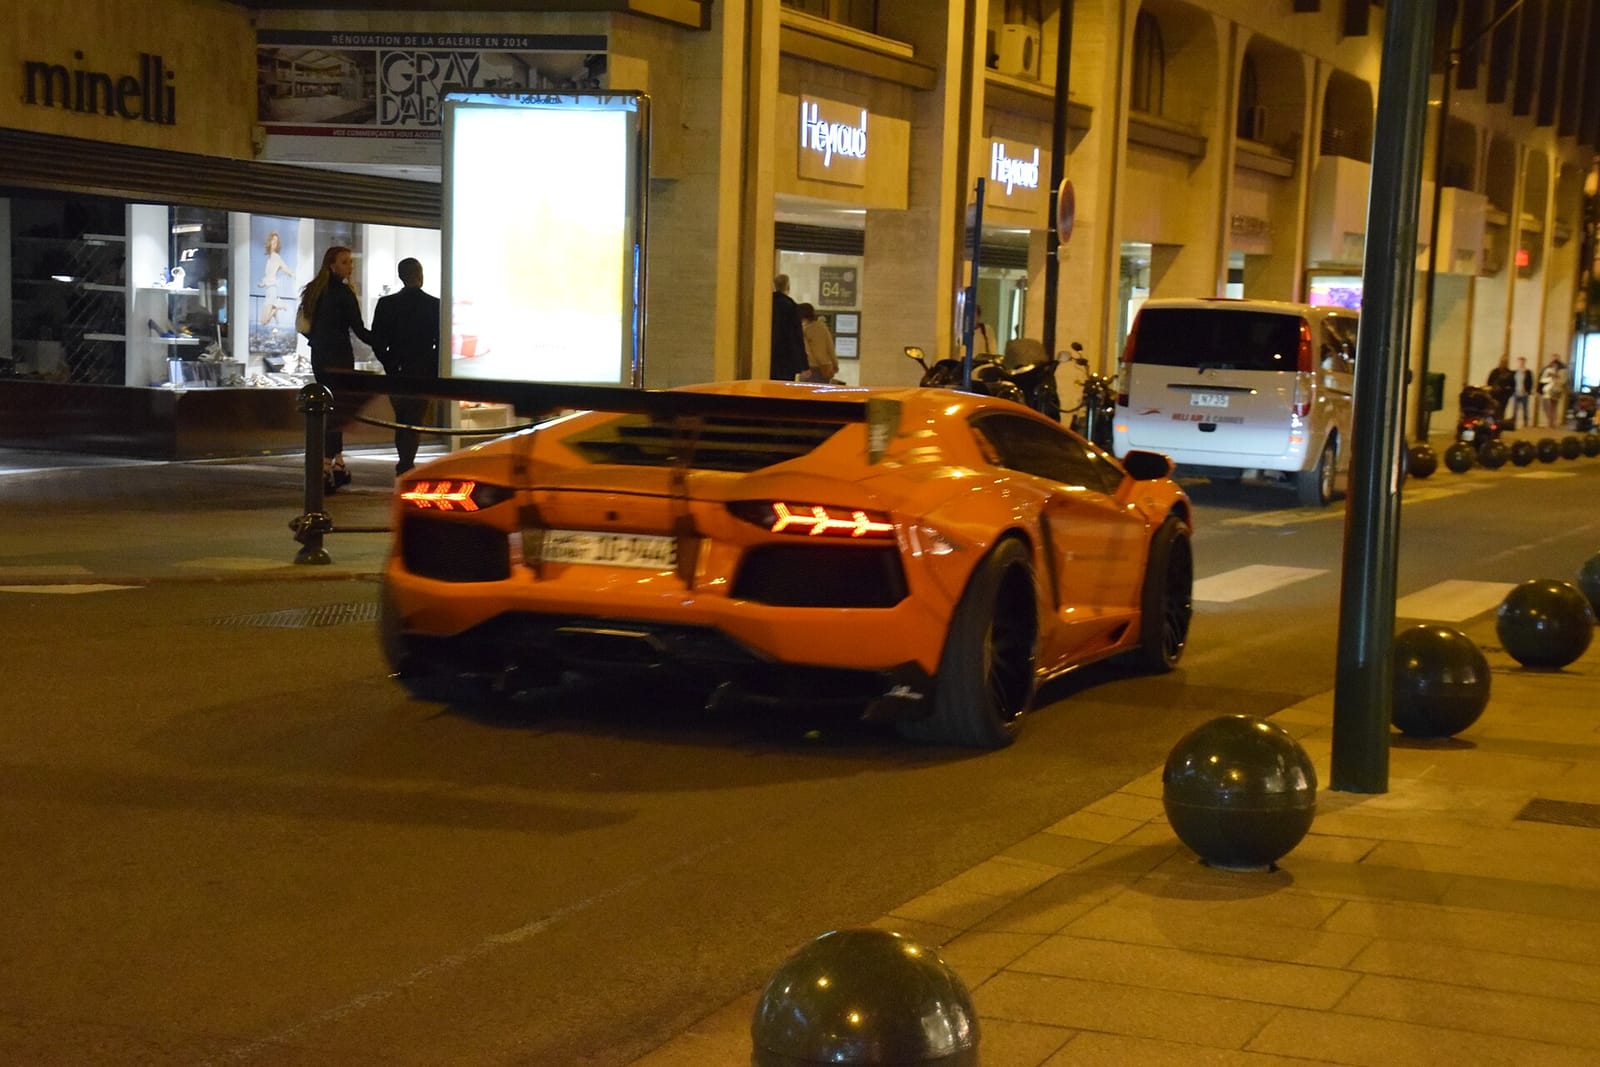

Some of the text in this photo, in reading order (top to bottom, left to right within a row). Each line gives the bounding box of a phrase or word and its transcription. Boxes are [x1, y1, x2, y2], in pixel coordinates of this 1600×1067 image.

[331, 34, 528, 47] RÉNOVATION DE LA GALERIE EN 2014
[24, 50, 176, 125] minelli
[822, 281, 840, 297] 64
